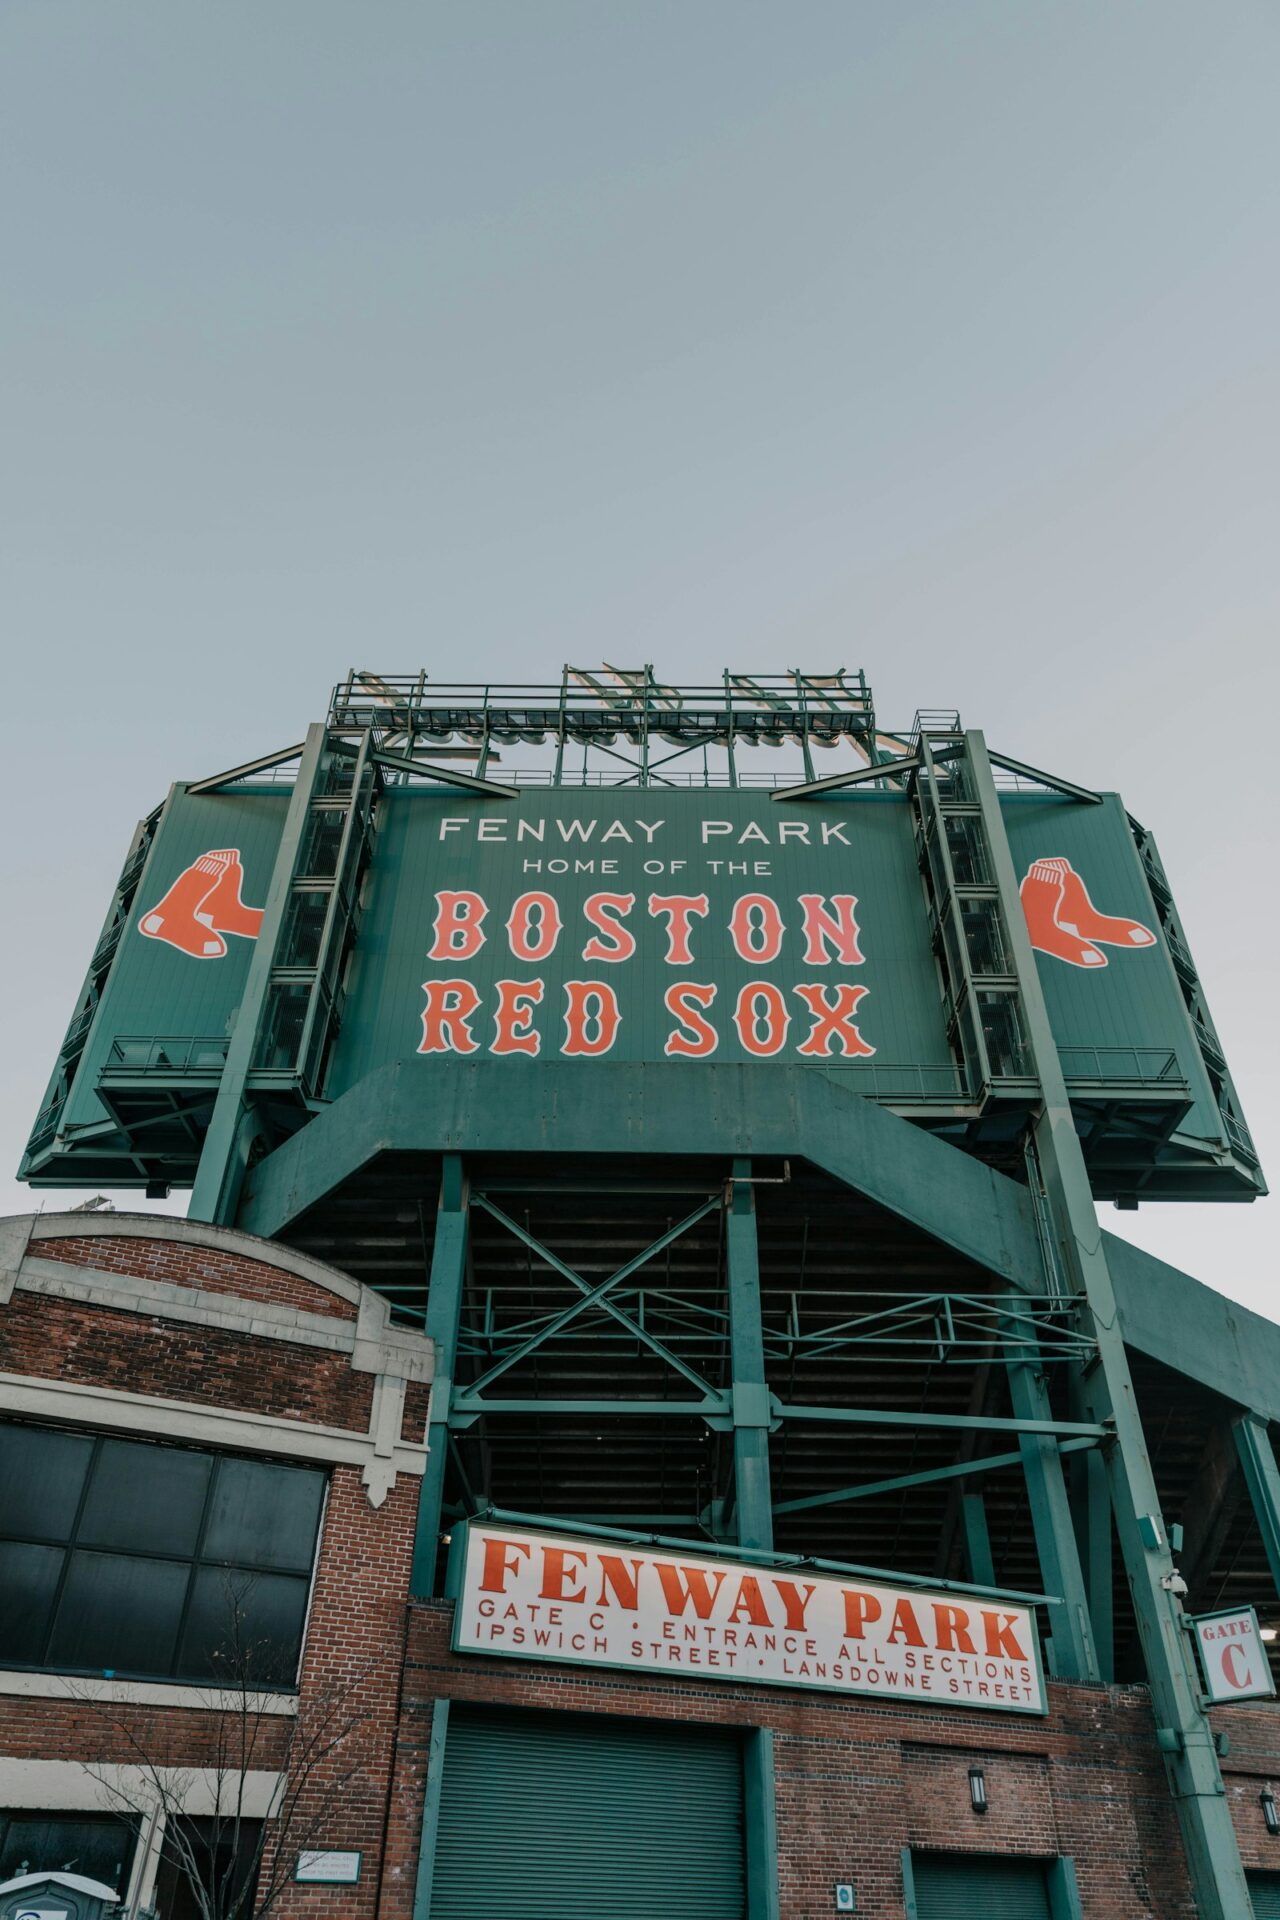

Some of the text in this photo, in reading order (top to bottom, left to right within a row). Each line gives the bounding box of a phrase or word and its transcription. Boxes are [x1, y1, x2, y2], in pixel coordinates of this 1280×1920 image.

[439, 818, 852, 845] FENWAY PARK
[522, 858, 772, 876] HOME OF THE
[426, 890, 867, 966] BOSTON
[416, 977, 877, 1058] RED SOX
[478, 1537, 1028, 1661] FENWAY PARK
[1202, 1619, 1252, 1641] GATE
[476, 1622, 1032, 1701] IPSWICH STREET LANSDOWNE STREET
[478, 1599, 1031, 1683] GATE C ENTRANCE ALL SECTIONS
[1221, 1643, 1253, 1689] C
